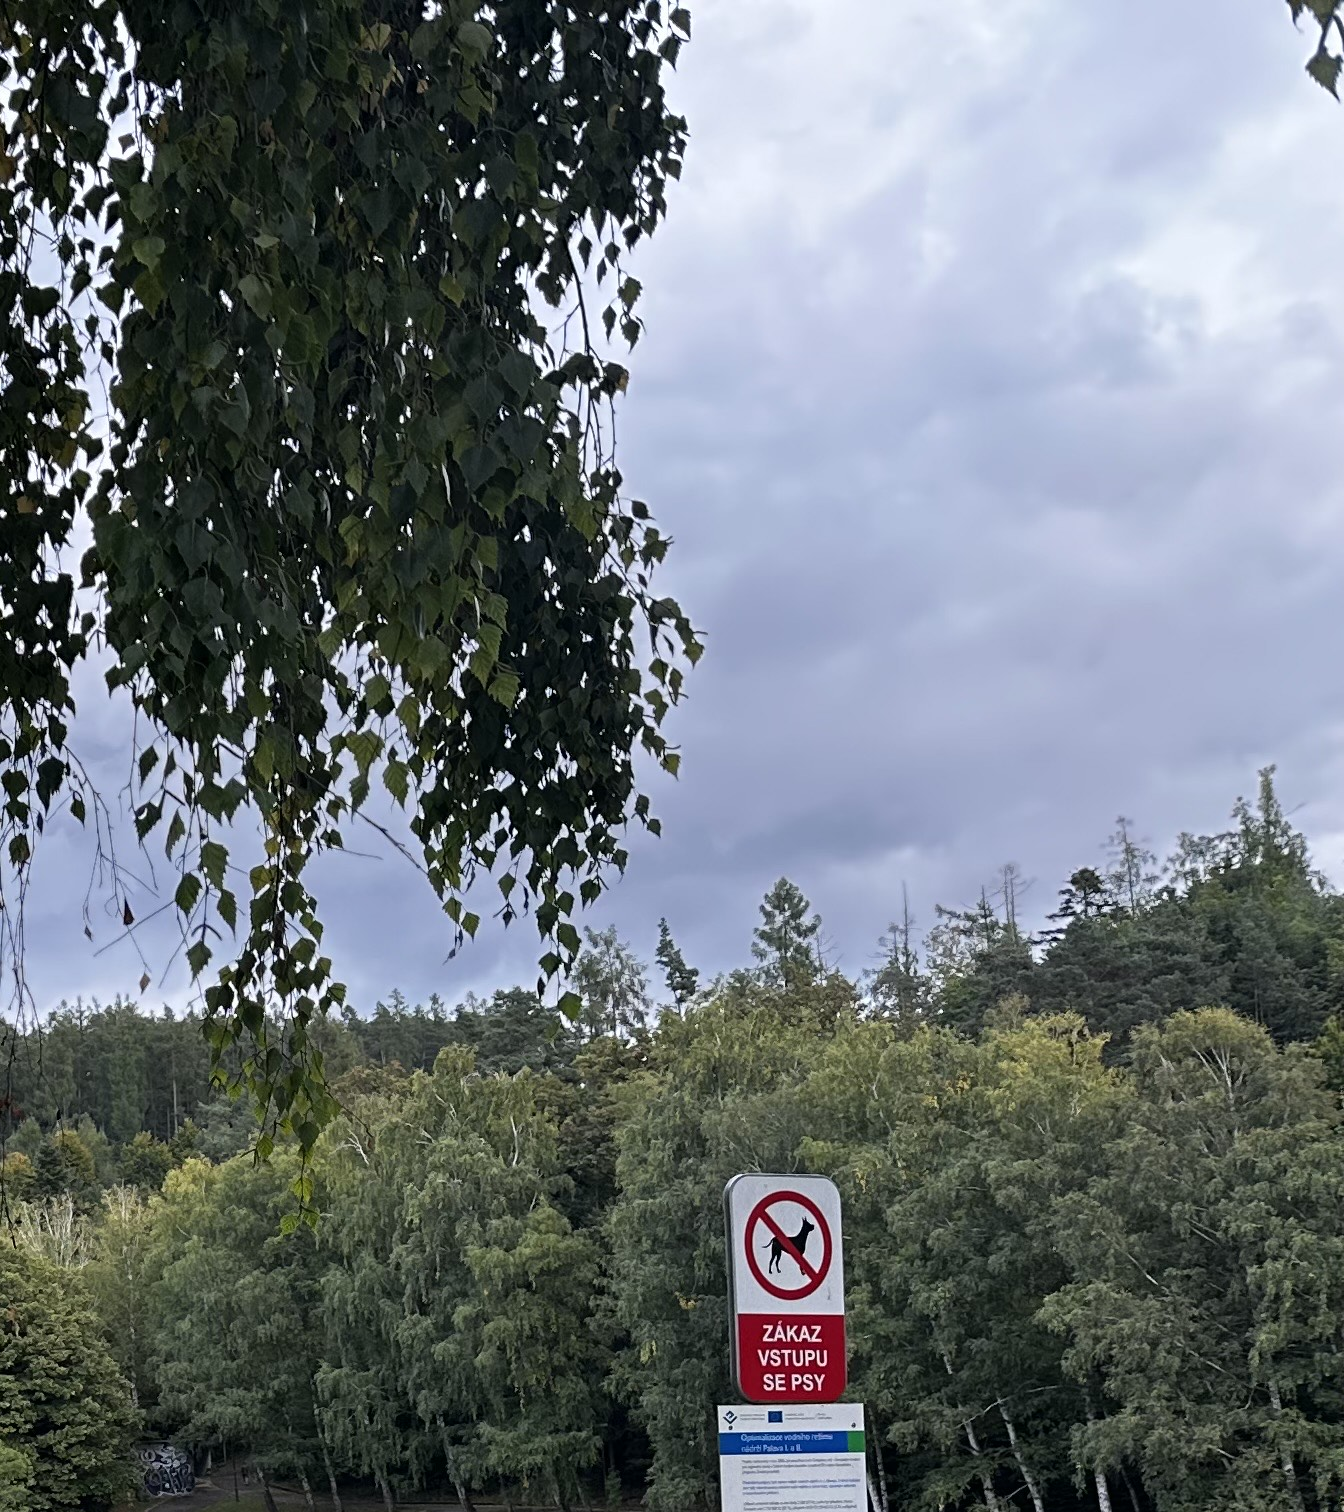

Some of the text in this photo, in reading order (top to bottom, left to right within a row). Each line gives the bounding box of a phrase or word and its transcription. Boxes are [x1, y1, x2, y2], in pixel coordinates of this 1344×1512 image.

[762, 1320, 822, 1342] ZÁKAZ
[757, 1349, 828, 1367] VSTUPU
[763, 1374, 825, 1391] SE PSY
